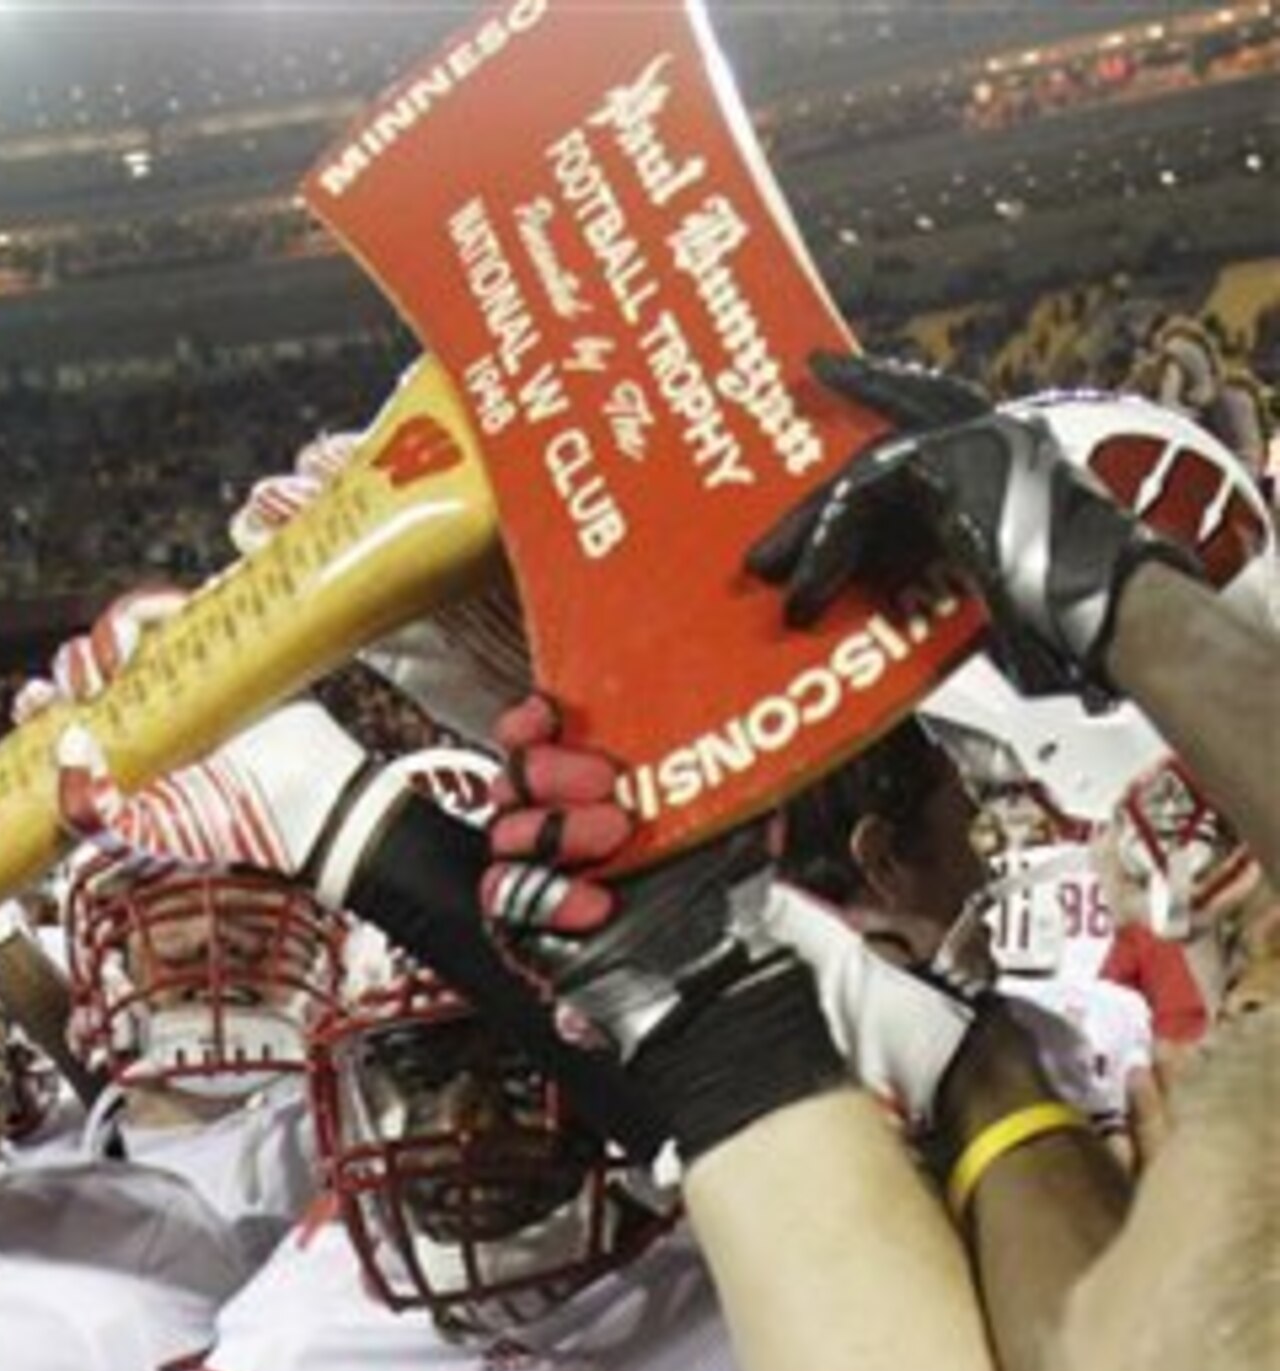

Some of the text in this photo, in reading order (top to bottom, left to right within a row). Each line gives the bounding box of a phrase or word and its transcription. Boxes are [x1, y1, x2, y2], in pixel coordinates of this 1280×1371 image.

[448, 197, 628, 558] NATIONAL W CLUB
[545, 129, 756, 488] FOOTBALL TROPHY
[615, 597, 958, 821] ISCONSI
